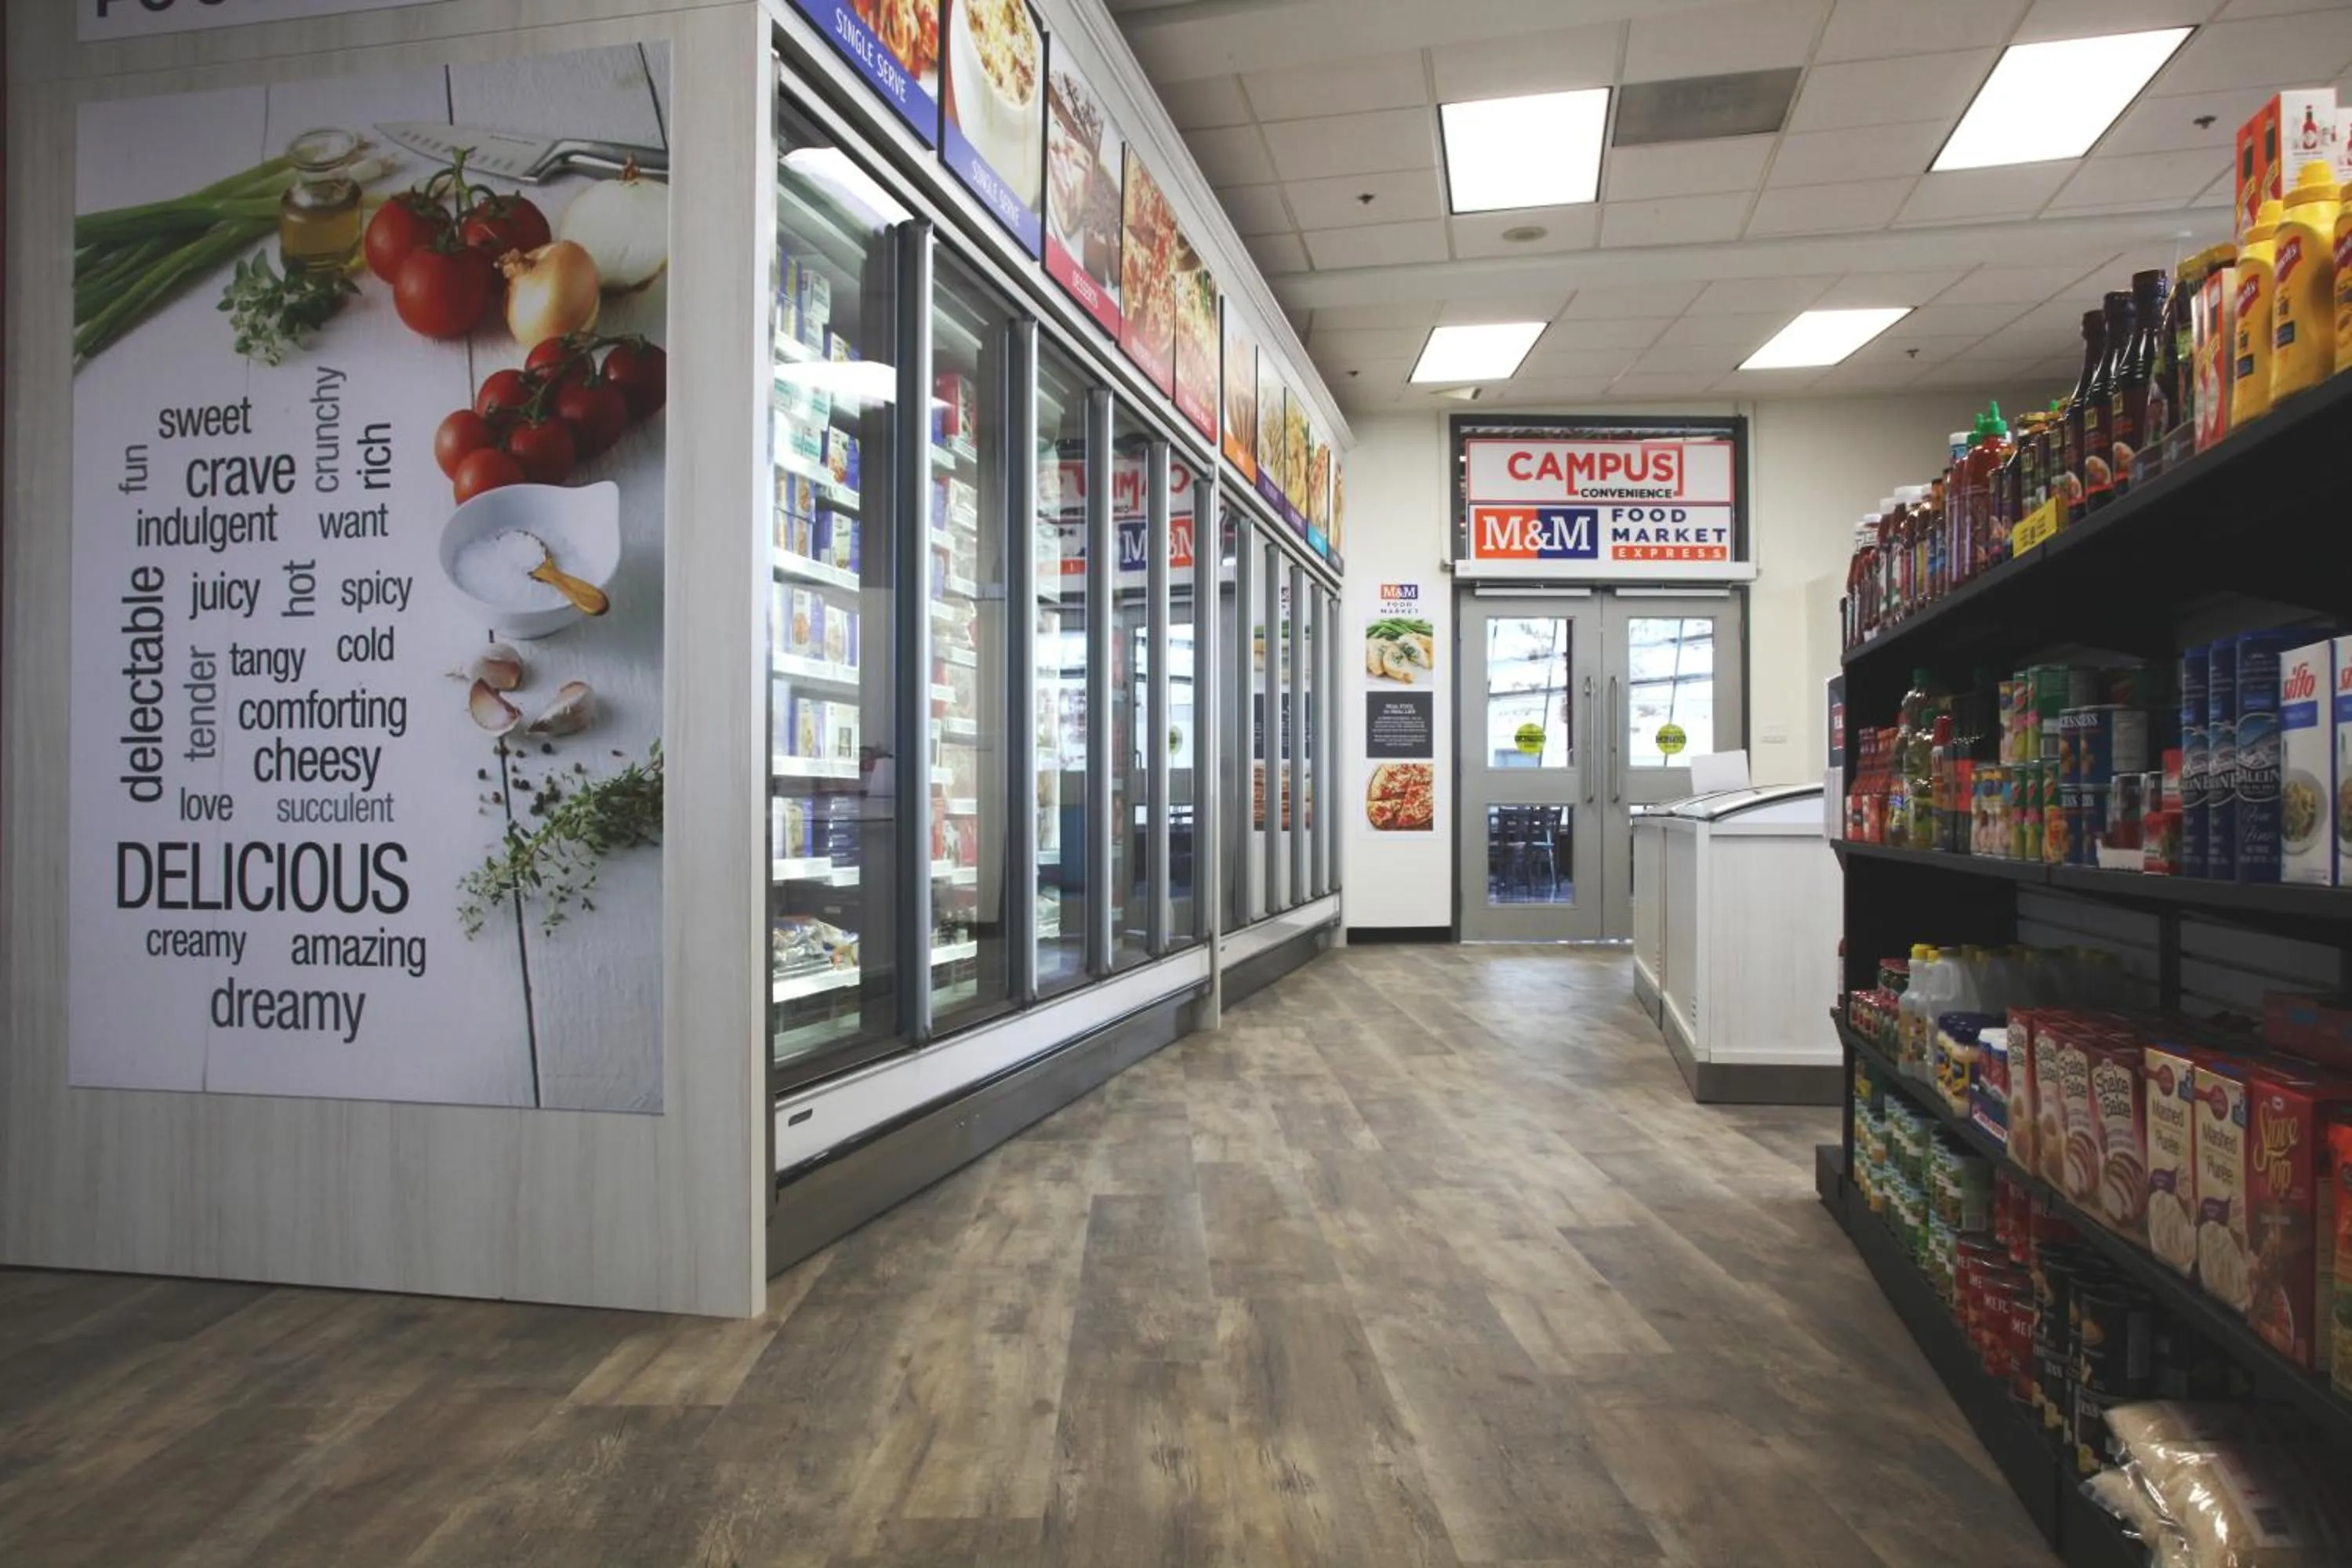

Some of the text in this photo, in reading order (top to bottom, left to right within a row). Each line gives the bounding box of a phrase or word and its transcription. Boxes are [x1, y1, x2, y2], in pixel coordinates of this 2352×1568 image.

[835, 7, 907, 103] SINGLE SERVE
[158, 396, 252, 439] sweet
[310, 365, 347, 493] crunchy
[119, 444, 149, 494] fun
[186, 452, 296, 498] crave
[356, 423, 391, 490] rich
[1508, 450, 1675, 483] CAMPUS
[1580, 488, 1672, 499] CONVENIENCE
[1611, 508, 1687, 523] FOOD
[136, 503, 278, 553] indulgent
[318, 503, 390, 539] want
[1482, 515, 1592, 551] M&M
[1612, 528, 1727, 543] MARKET
[1617, 547, 1724, 558] EXPRESS
[189, 571, 261, 620] juicy
[281, 559, 316, 617] hot
[340, 569, 413, 613] spicy
[1383, 586, 1416, 598] M&M
[229, 642, 307, 683] tangy
[336, 625, 394, 662] cold
[120, 565, 165, 802] delectable
[183, 644, 216, 762] tender
[238, 688, 408, 737] comforting
[253, 737, 382, 792] cheesy
[180, 787, 234, 821] love
[277, 792, 394, 822] succulent
[117, 841, 410, 914] DELICIOUS
[146, 928, 247, 965] creamy
[291, 927, 426, 978] amazing
[210, 977, 366, 1044] dreamy
[2253, 1100, 2300, 1173] Stove
[2267, 1156, 2292, 1199] Top
